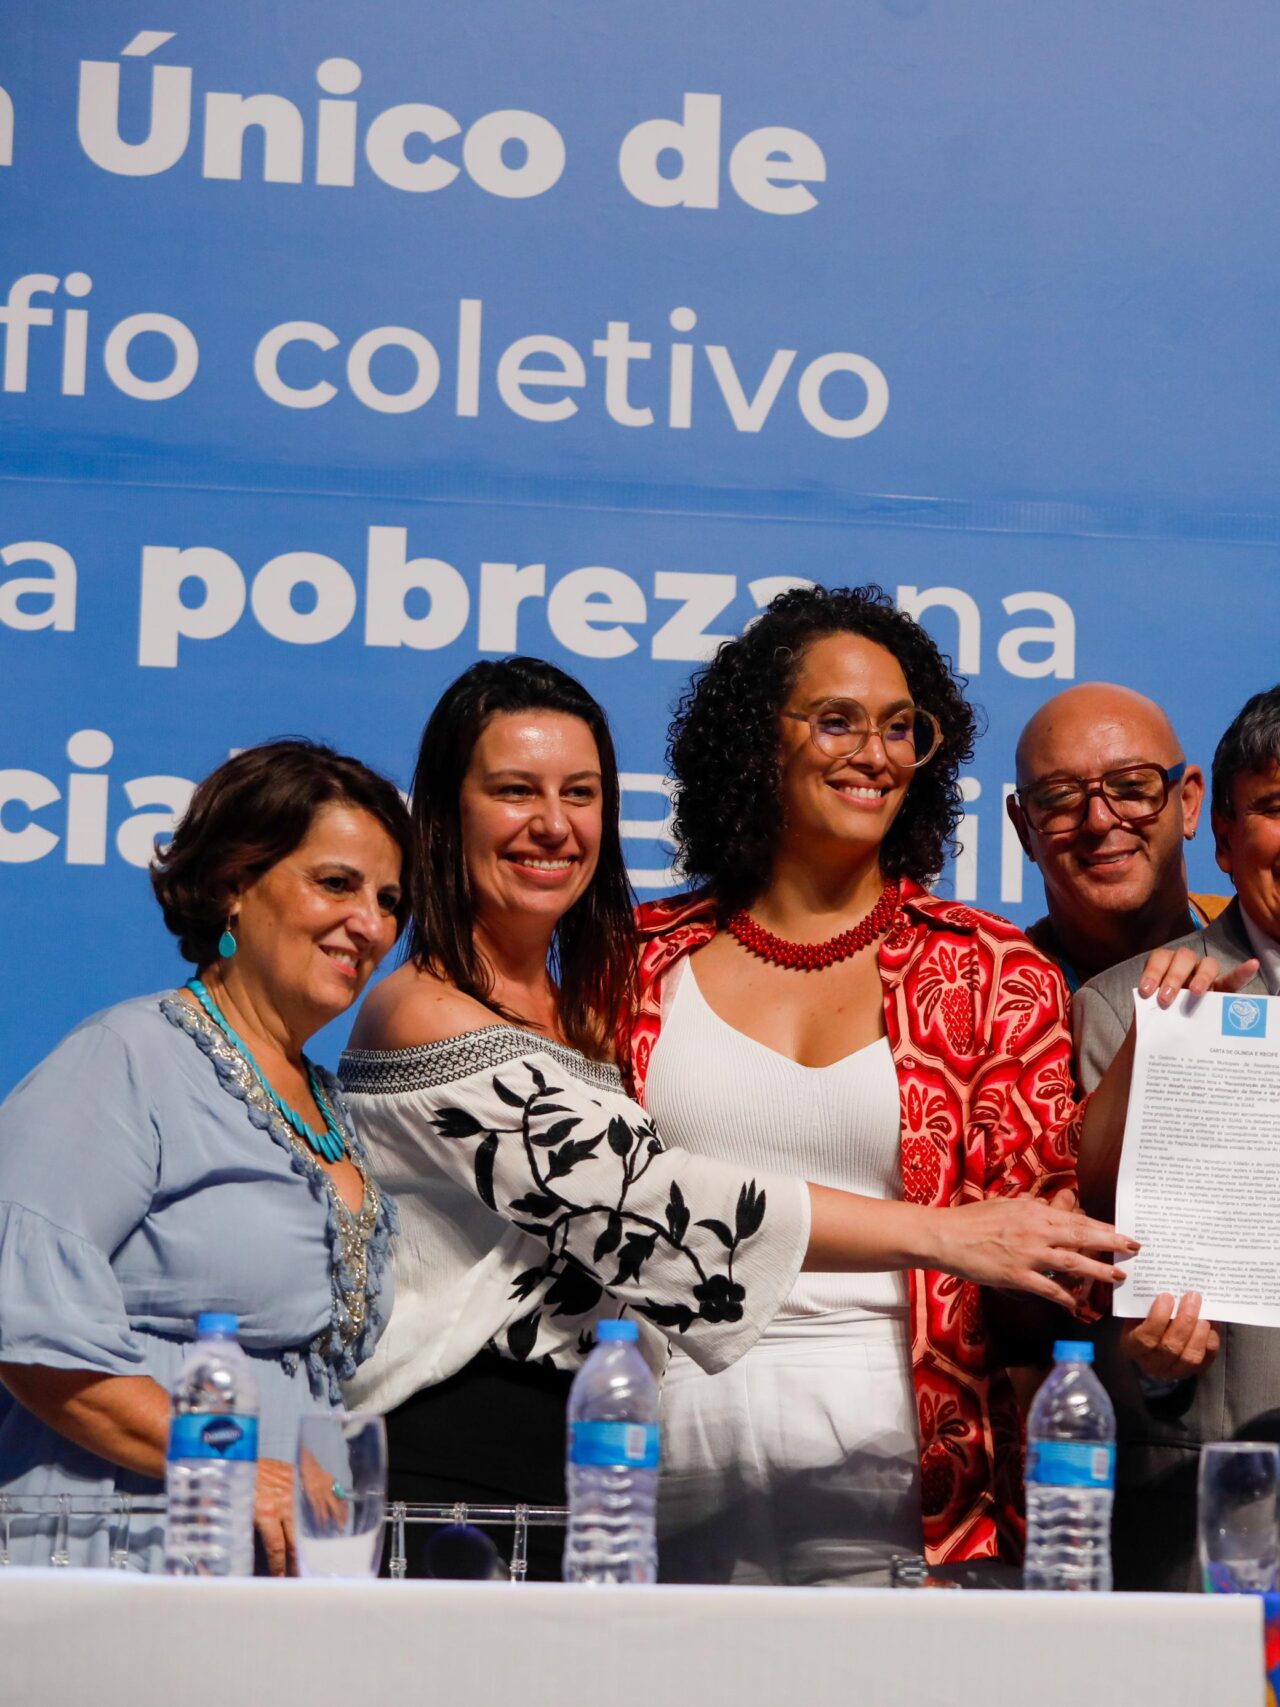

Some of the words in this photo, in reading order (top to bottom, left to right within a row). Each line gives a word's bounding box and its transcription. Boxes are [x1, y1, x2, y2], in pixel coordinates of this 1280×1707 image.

[77, 30, 566, 199] Único
[618, 92, 827, 215] de
[253, 298, 889, 440] coletivo
